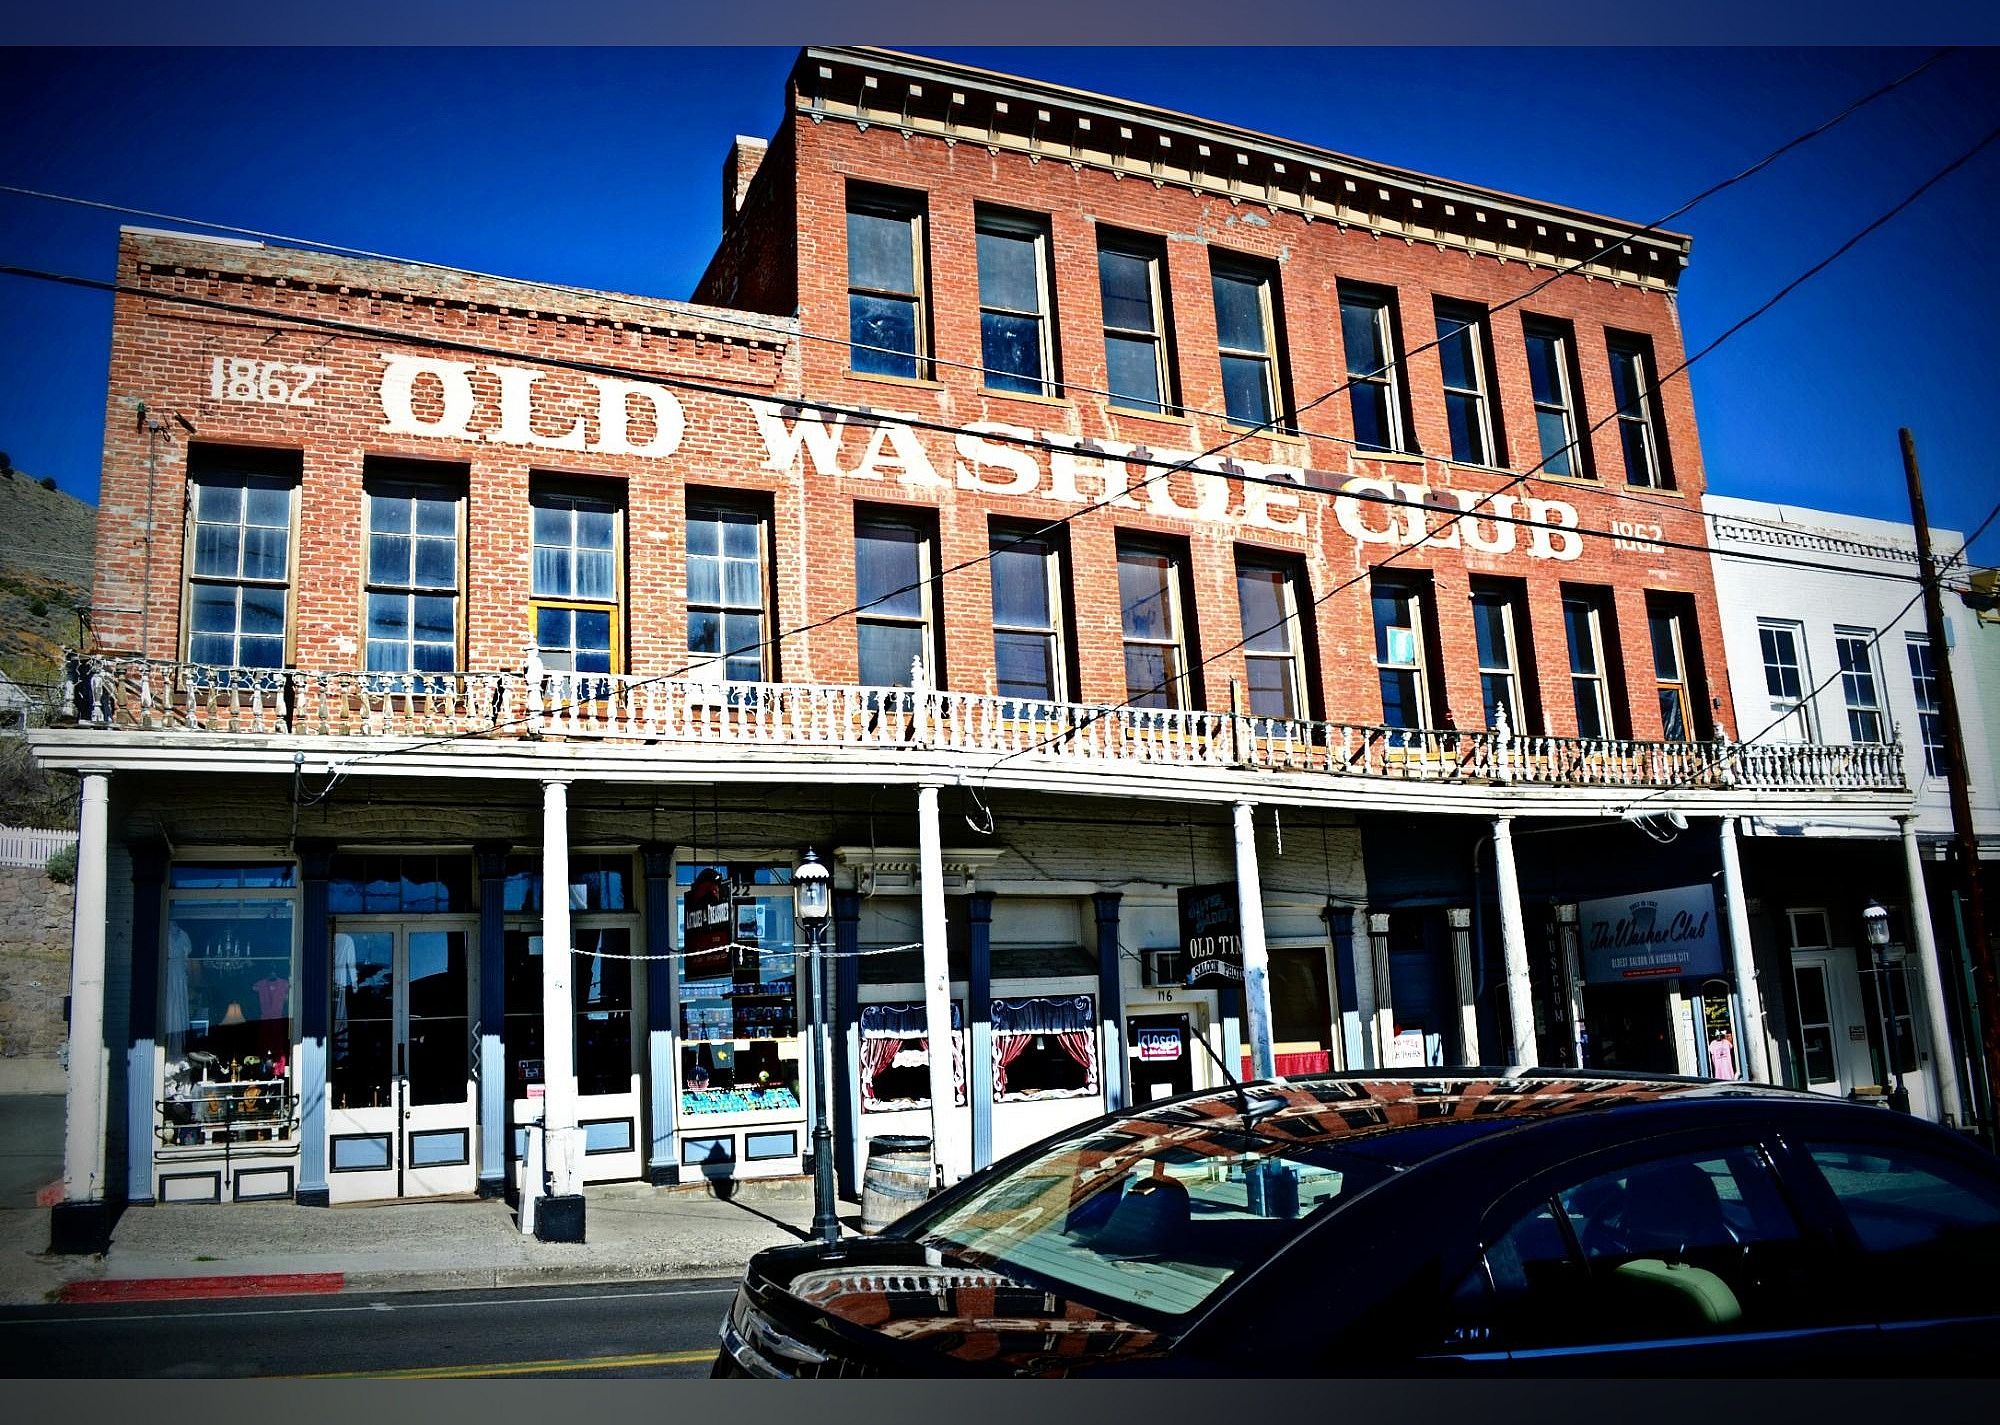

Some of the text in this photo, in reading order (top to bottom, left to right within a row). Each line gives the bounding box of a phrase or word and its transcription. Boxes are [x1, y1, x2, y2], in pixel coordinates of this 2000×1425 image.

[210, 356, 333, 406] 1862
[379, 351, 1584, 562] OLD WASHOE CLUB
[1611, 519, 1665, 555] 1862
[1670, 909, 1709, 942] Club
[1189, 937, 1214, 959] OLD
[1194, 960, 1219, 978] SALOON
[1546, 923, 1563, 1022] MUSEUM
[1157, 989, 1173, 1002] 116
[1141, 1033, 1179, 1047] CLOSED
